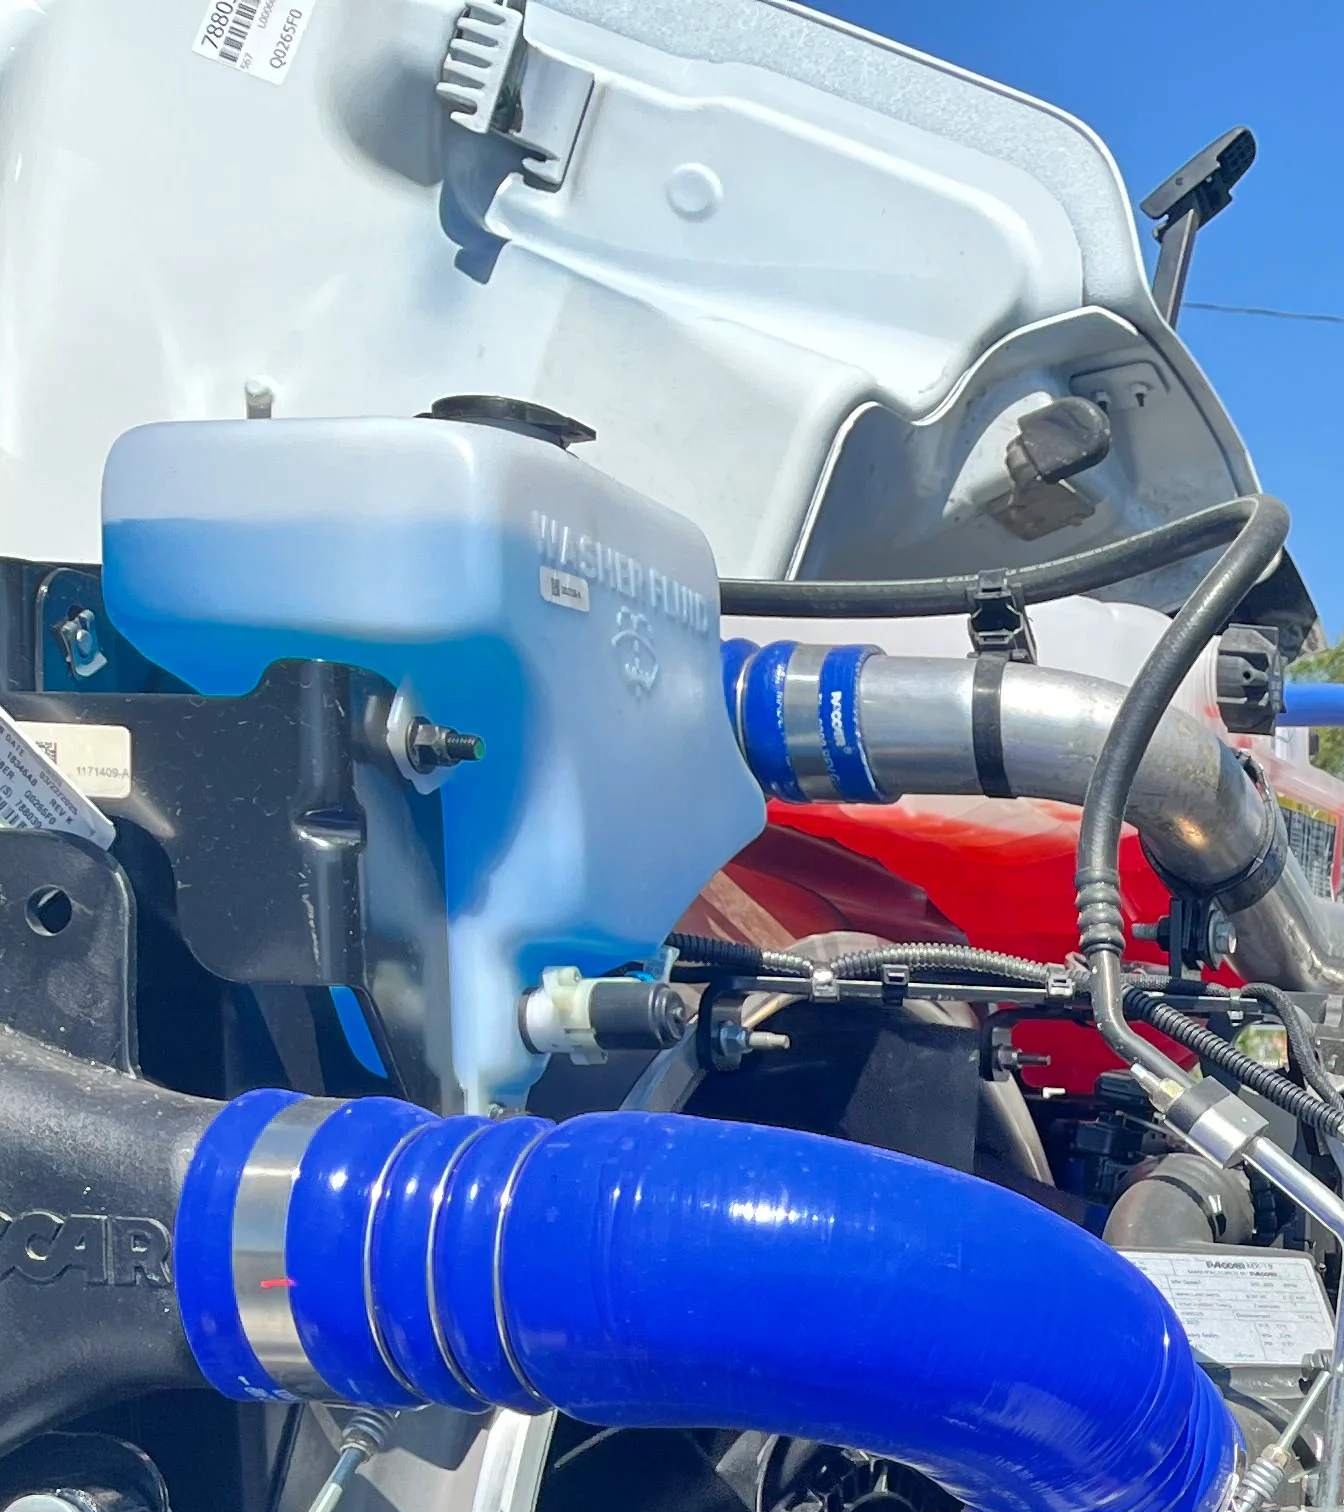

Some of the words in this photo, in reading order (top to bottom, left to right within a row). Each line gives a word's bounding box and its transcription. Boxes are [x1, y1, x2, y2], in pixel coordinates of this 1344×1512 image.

[201, 0, 238, 49] 7880
[269, 8, 302, 69] Q0265F0
[531, 510, 643, 600] WASHER
[650, 567, 709, 633] FLUID
[5, 733, 26, 757] DATE
[76, 766, 129, 778] 1171409-A
[49, 799, 67, 817] REV
